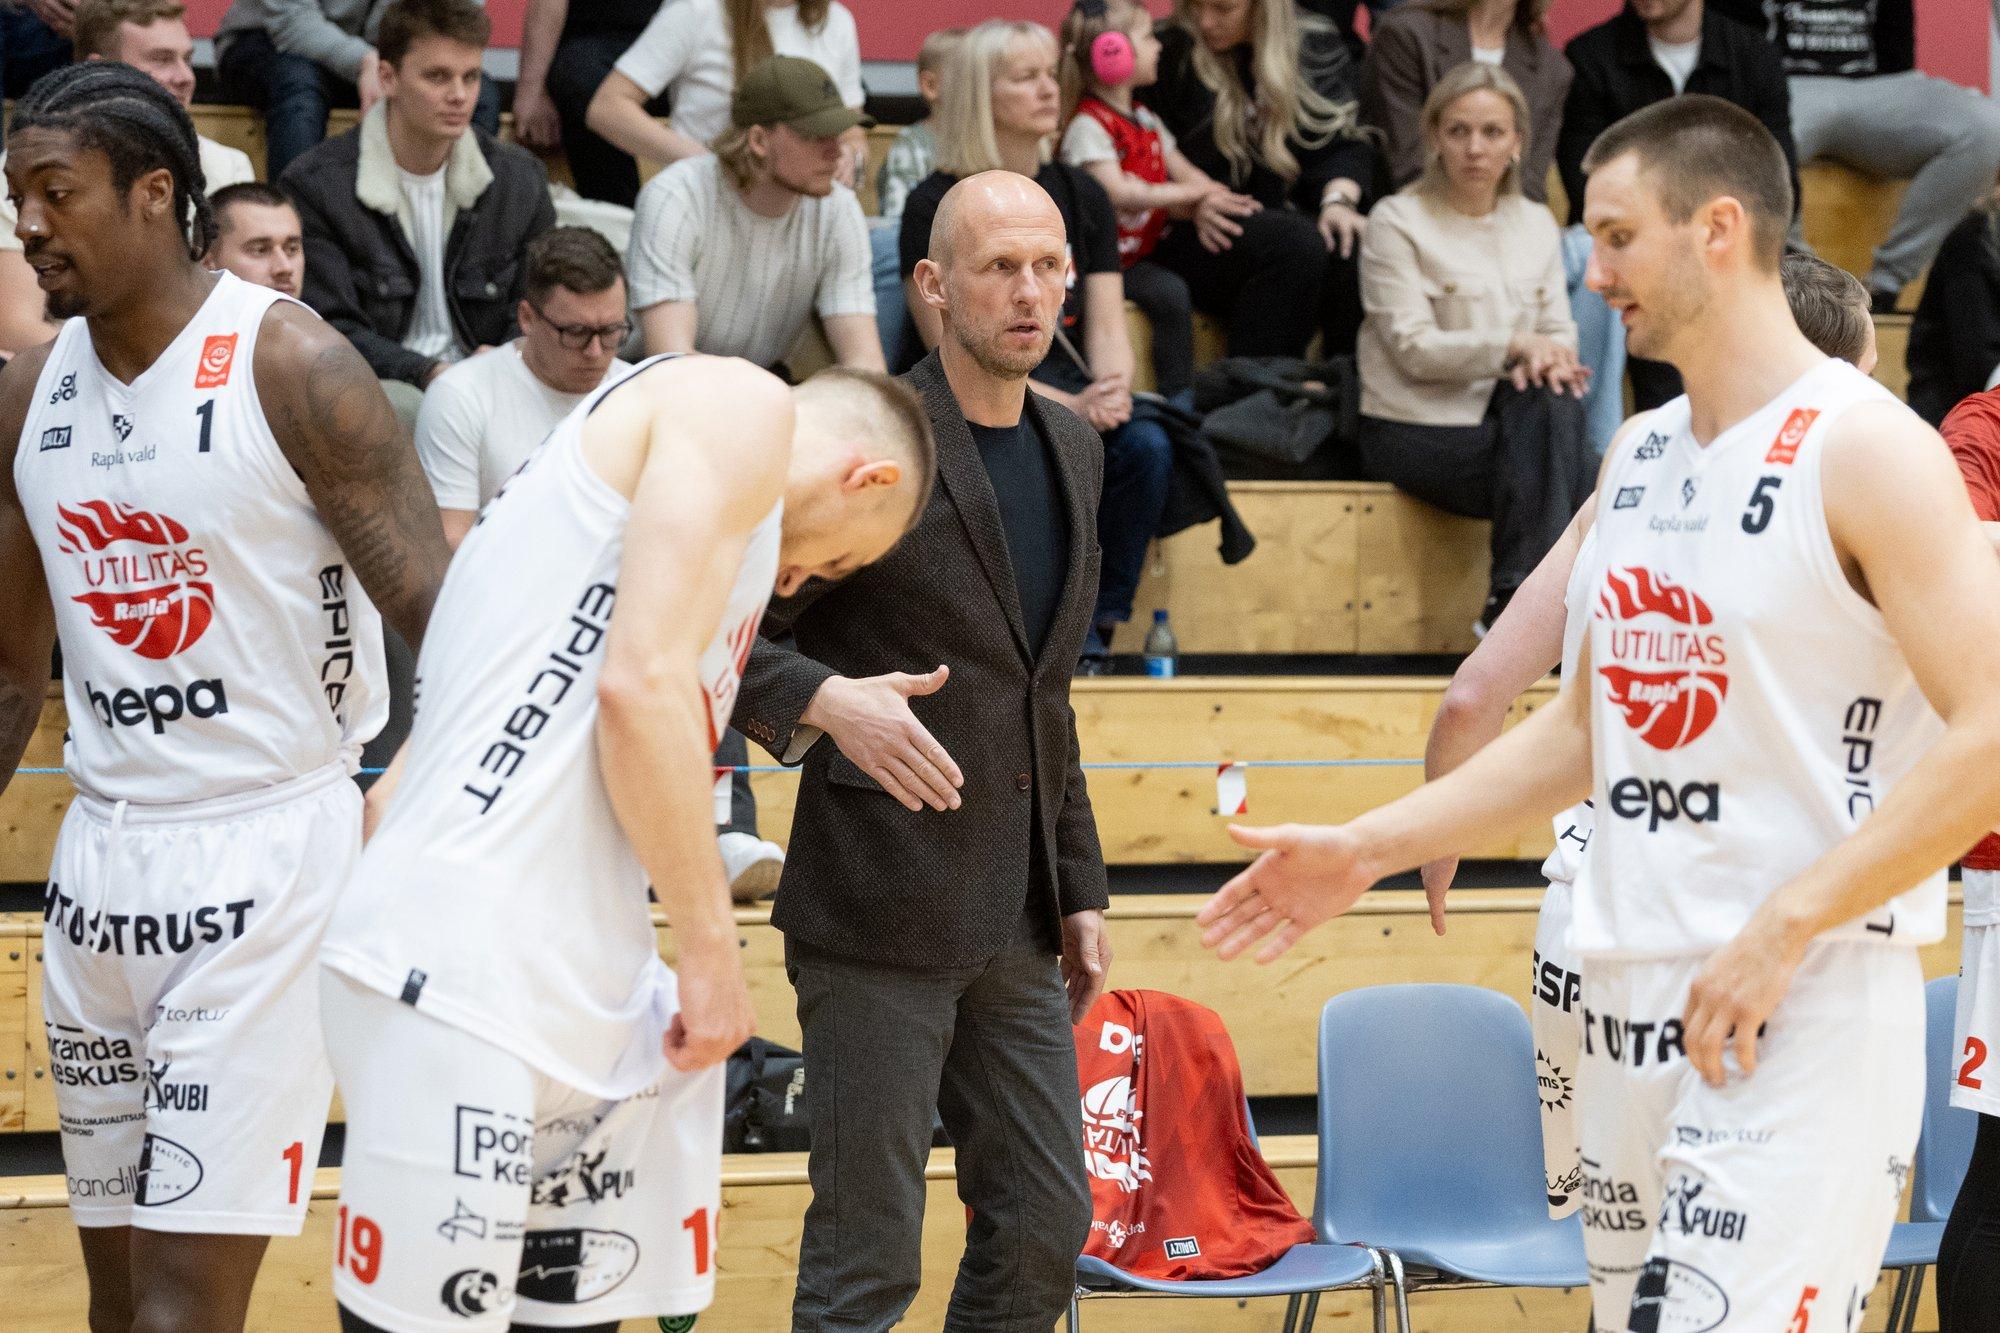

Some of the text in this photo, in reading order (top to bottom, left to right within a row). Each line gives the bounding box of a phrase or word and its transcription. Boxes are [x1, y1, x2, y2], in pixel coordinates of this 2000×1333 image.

[196, 400, 214, 452] 1
[92, 444, 156, 470] Rapla vald
[1741, 476, 1782, 534] 5
[84, 548, 208, 587] UTILITAS
[114, 597, 170, 622] Rapla
[1611, 630, 1726, 666] UTILITAS
[463, 582, 616, 816] EPICBET
[1609, 776, 1720, 833] epa
[1957, 1036, 1988, 1090] 2
[163, 1083, 209, 1112] PUBI
[282, 1141, 303, 1205] 1
[1691, 1206, 1747, 1242] PUBI
[1786, 1284, 1819, 1333] 5
